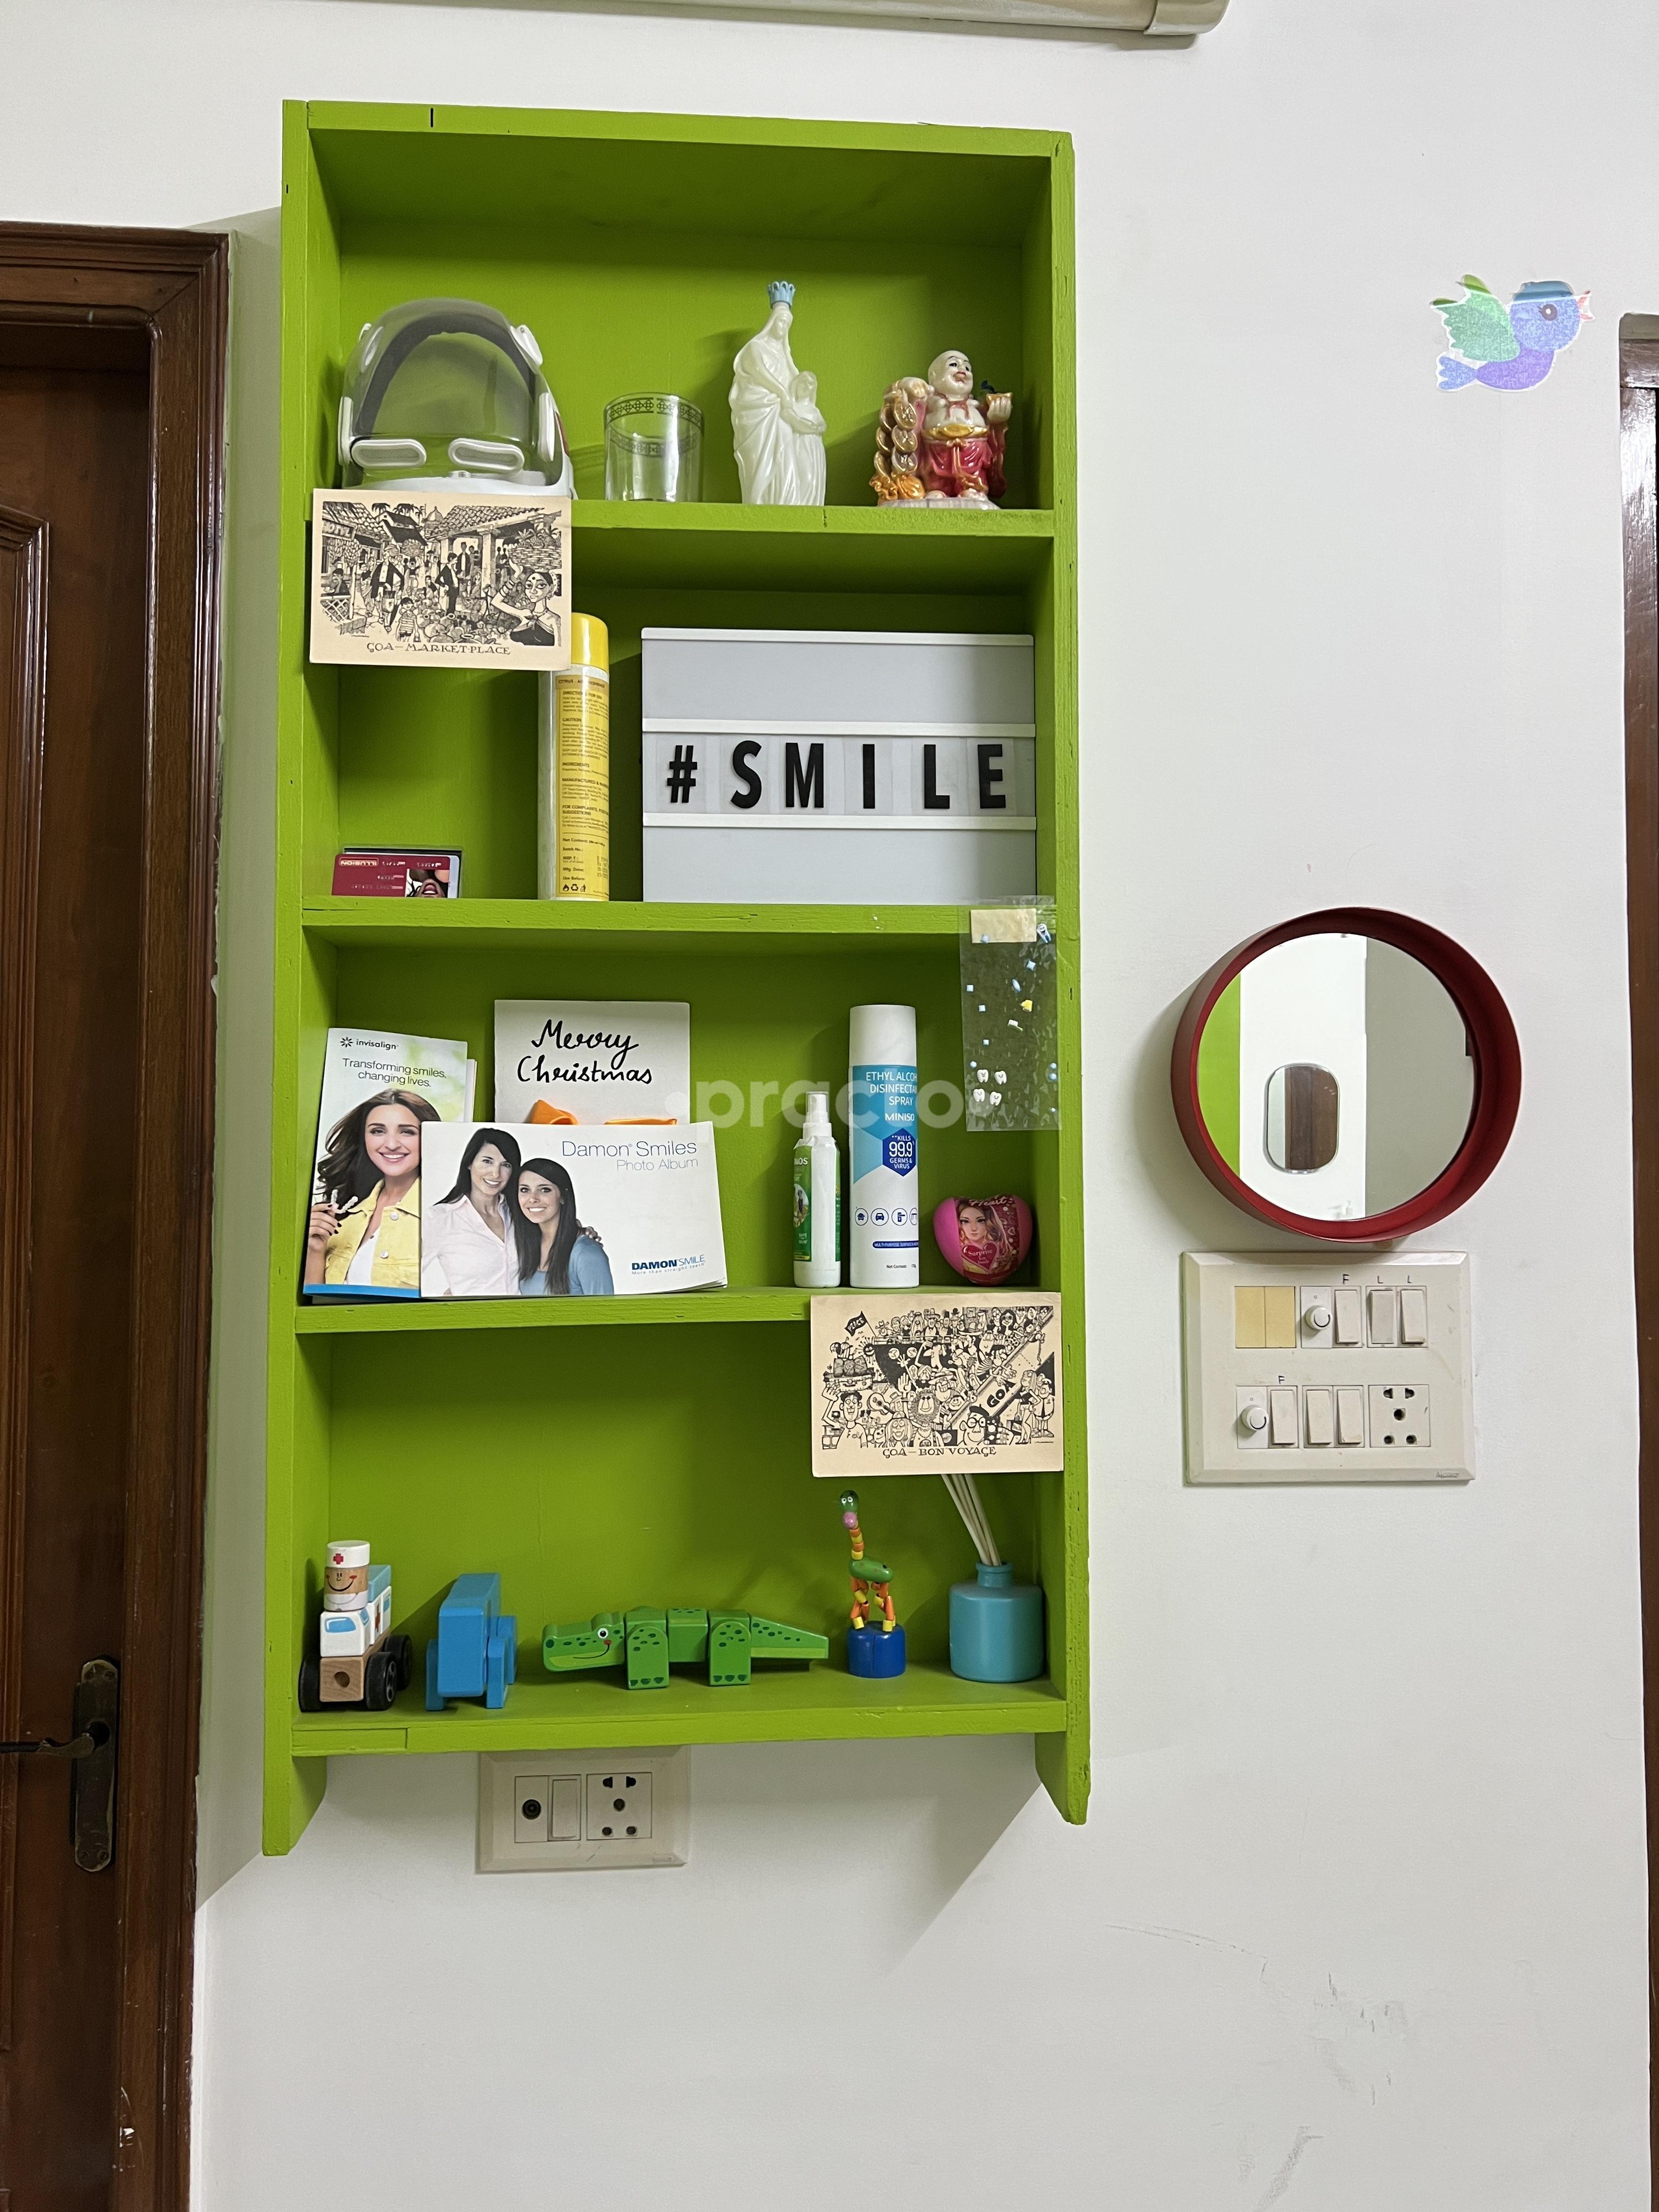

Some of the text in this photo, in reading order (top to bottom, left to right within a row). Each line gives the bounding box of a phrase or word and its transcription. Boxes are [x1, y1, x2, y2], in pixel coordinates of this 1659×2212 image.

[356, 1039, 397, 1051] invisalign
[531, 1019, 639, 1070] Merry
[342, 1058, 411, 1075] Transforming
[517, 1054, 652, 1084] Christmas
[358, 1070, 432, 1087] changing lives.
[866, 1071, 894, 1081] ETHYL
[889, 1096, 913, 1106] SPRAY
[885, 1113, 915, 1121] MINISO
[636, 1140, 697, 1157] Smiles
[616, 1157, 699, 1171] Photo Album
[1342, 1274, 1350, 1285] F
[1377, 1276, 1383, 1284] L
[1278, 1375, 1285, 1384] F
[918, 1448, 944, 1456] BON
[946, 1447, 997, 1457] VOYAGE
